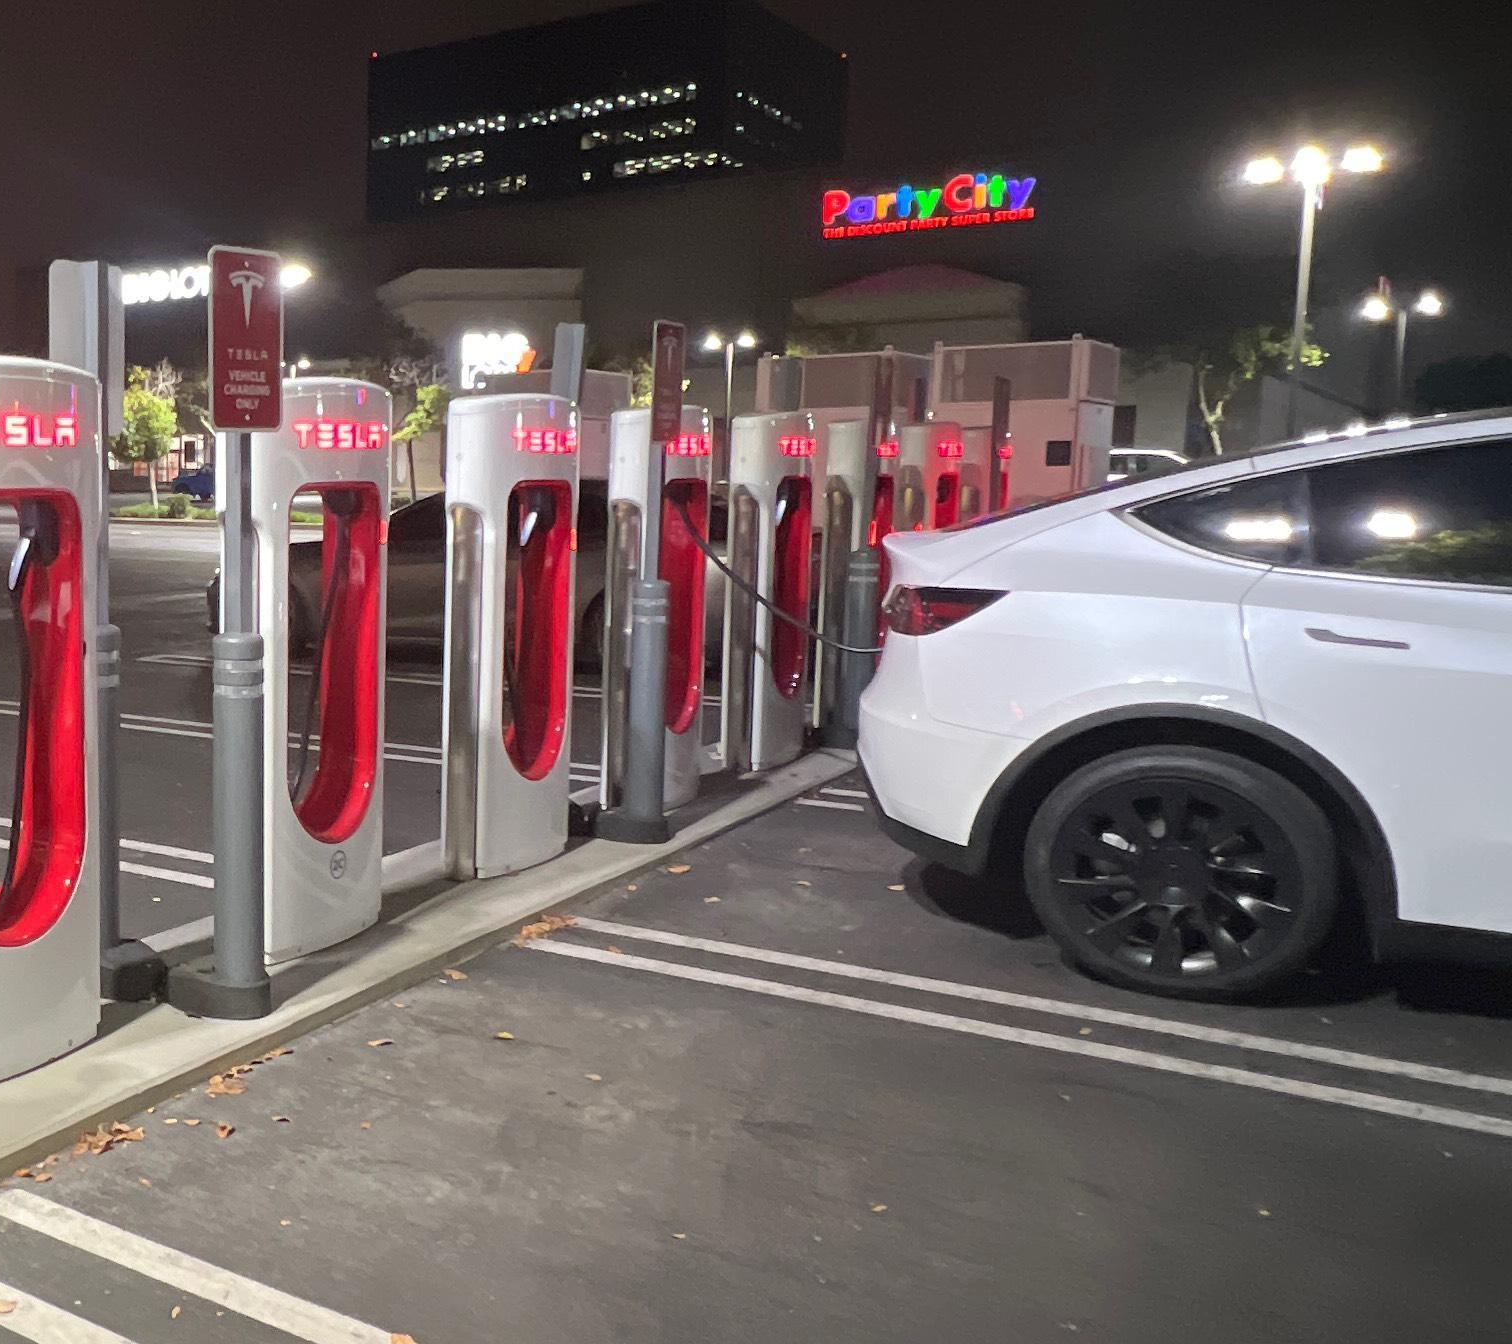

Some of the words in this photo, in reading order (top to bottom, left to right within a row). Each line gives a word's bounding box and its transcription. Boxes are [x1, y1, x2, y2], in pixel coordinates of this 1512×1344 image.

[822, 184, 942, 226] Party
[944, 172, 1037, 211] City
[910, 216, 949, 232] PARTY
[951, 212, 990, 227] SUPER
[170, 265, 210, 300] LOT
[227, 348, 269, 361] TESLA
[228, 369, 267, 384] VEHICLE
[235, 398, 260, 410] ONLY
[293, 422, 384, 449] TESLA
[512, 429, 577, 453] TESLA
